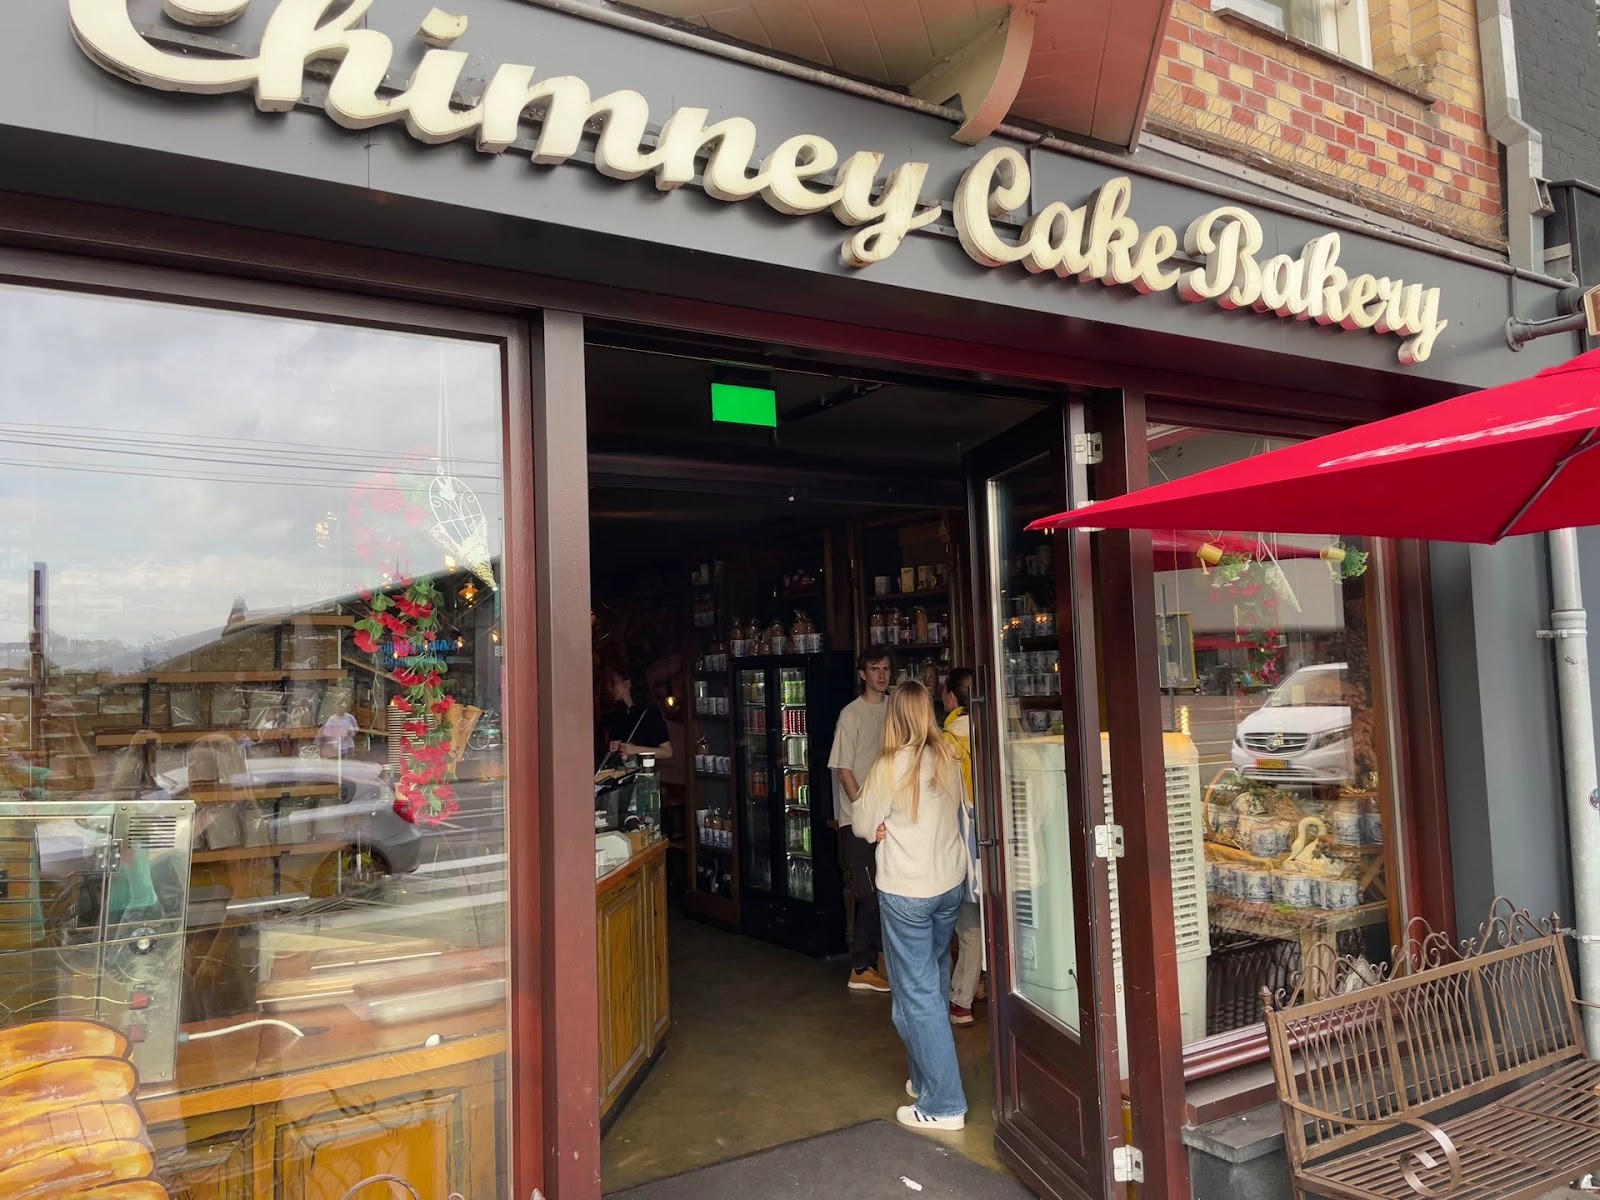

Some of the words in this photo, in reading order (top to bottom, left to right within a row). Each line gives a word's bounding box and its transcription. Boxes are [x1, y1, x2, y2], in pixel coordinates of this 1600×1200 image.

[69, 0, 942, 268] Chimney
[953, 147, 1181, 294] Cake
[1178, 206, 1448, 365] Bakery
